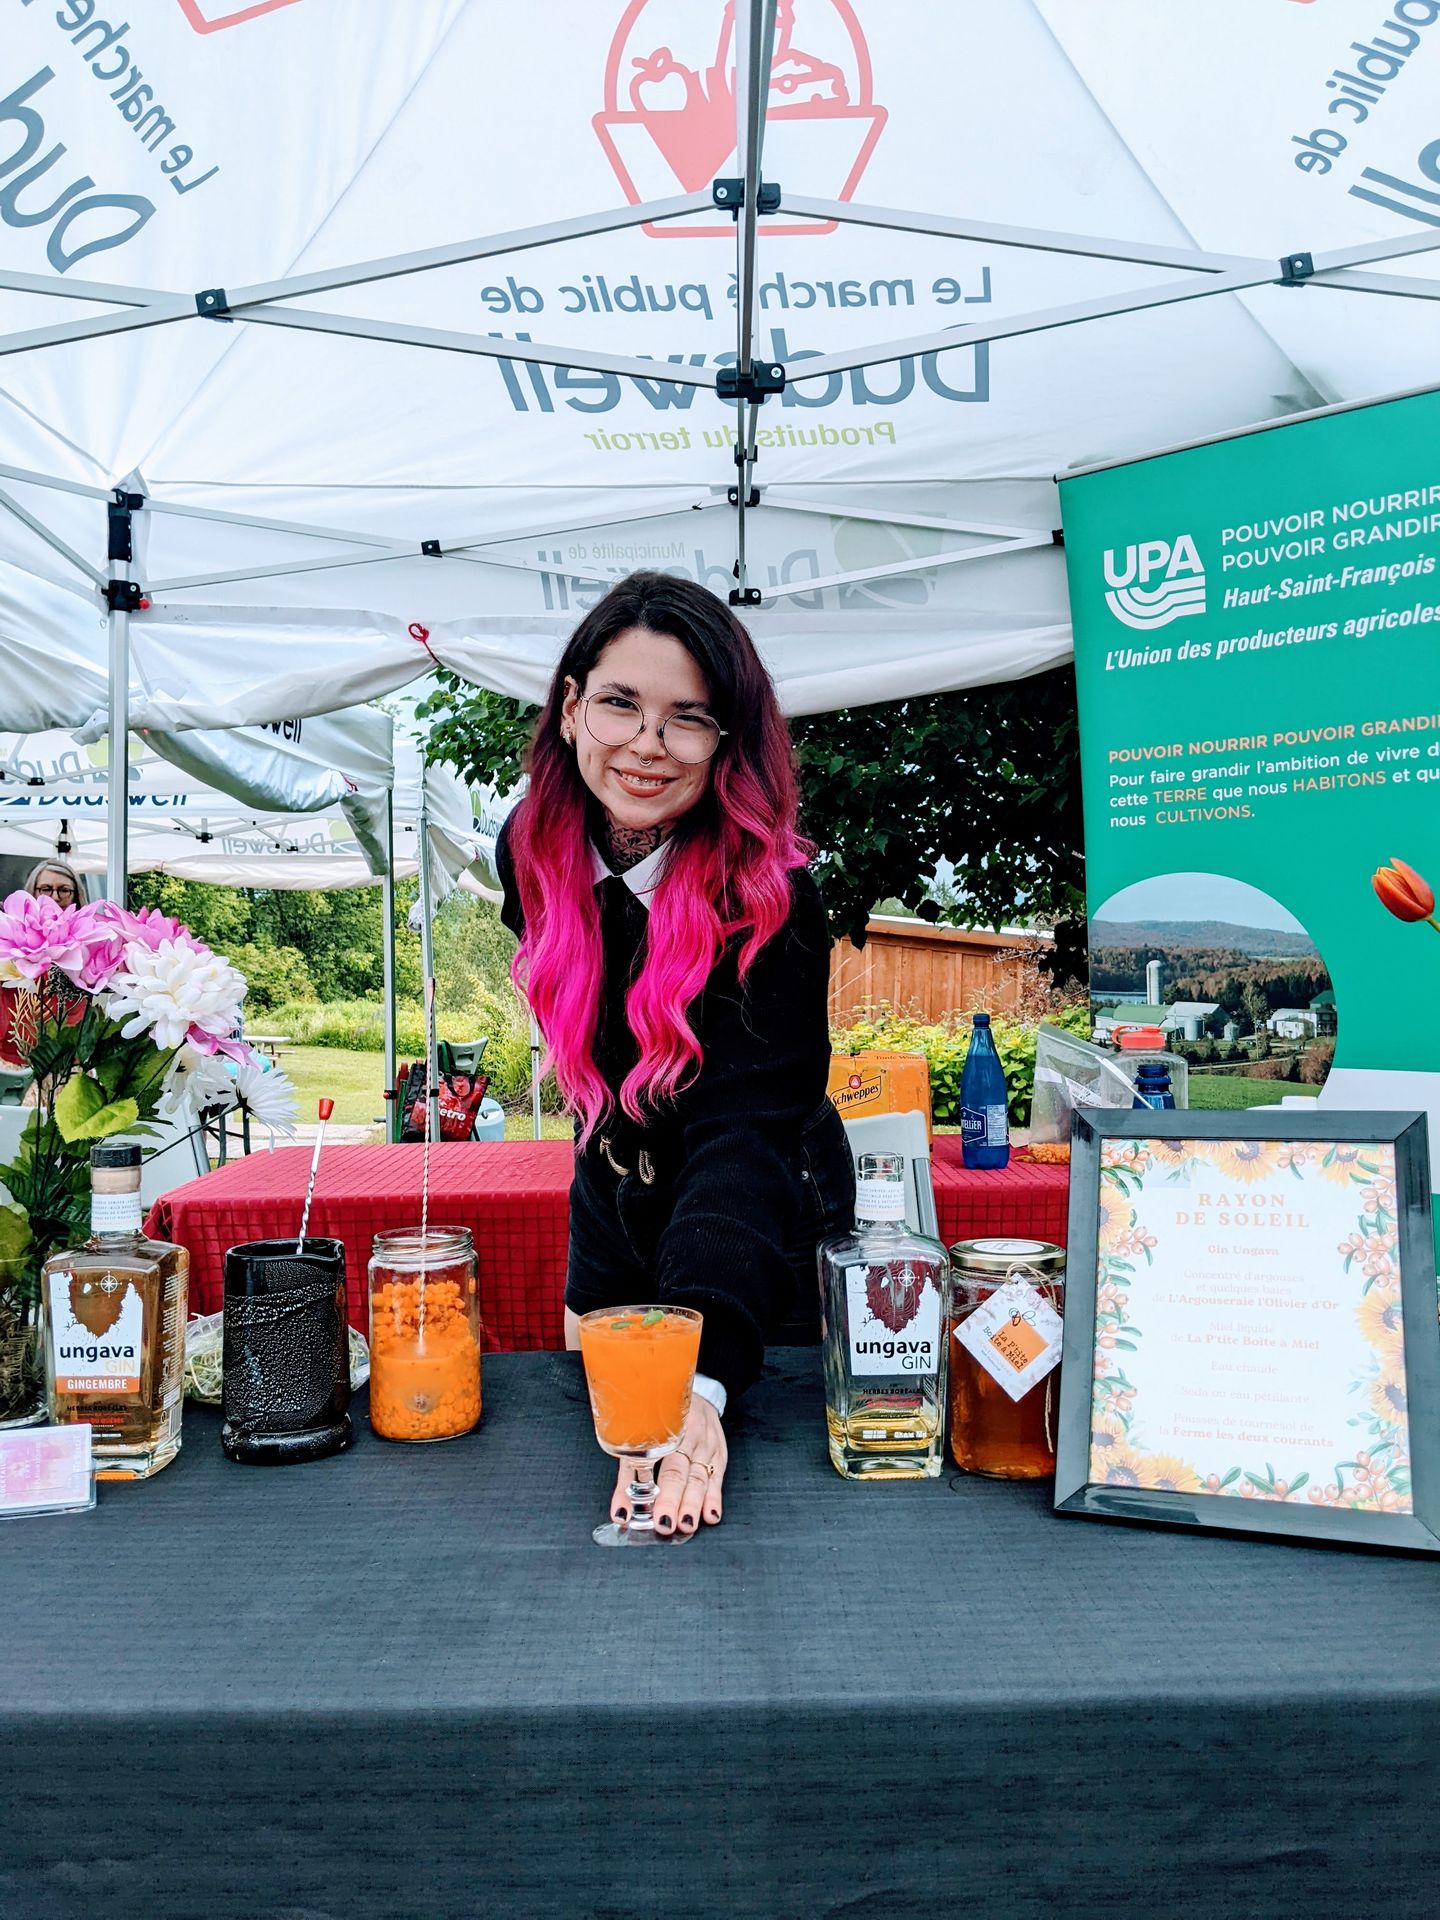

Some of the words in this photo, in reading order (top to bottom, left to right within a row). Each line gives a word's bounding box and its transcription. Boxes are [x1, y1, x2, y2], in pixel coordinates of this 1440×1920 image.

[1221, 510, 1325, 546] POUVOIR
[1103, 534, 1206, 588] UPA
[1221, 537, 1326, 572] POUVOIR
[1223, 553, 1437, 609] Haut-Saint-François
[1105, 646, 1172, 671] L'Union
[1177, 639, 1212, 662] des
[1216, 622, 1338, 660] producteurs
[1108, 743, 1183, 764] POUVOIR
[1188, 735, 1268, 755] NOURRIR
[1273, 725, 1355, 747] POUVOIR
[1360, 713, 1440, 737] GRANDI
[1109, 773, 1144, 788] Pour
[1150, 769, 1185, 784] faire
[1191, 763, 1250, 784] grandir
[1256, 755, 1340, 774] l'ambition
[1346, 750, 1369, 765] de
[1375, 745, 1420, 762] vivre
[1110, 792, 1148, 808] cette
[1153, 787, 1207, 804] TERRE
[1212, 785, 1243, 802] que
[1248, 781, 1288, 796] nous
[1292, 770, 1387, 793] HABITONS
[1392, 768, 1411, 783] et
[1110, 813, 1146, 828] nous
[1155, 804, 1256, 825] CULTIVONS.
[832, 1083, 880, 1107] Schweppes
[1198, 1193, 1285, 1208] RAYON
[1175, 1211, 1206, 1225] DE
[1218, 1212, 1310, 1229] SOLEIL
[1207, 1244, 1229, 1255] Gin
[1232, 1245, 1280, 1257] Ungava
[1168, 1293, 1254, 1308] L'Argouseraie
[1311, 1299, 1340, 1310] d'Or
[855, 1341, 931, 1359] ungava
[1187, 1333, 1202, 1344] La
[1291, 1338, 1320, 1351] Miel
[59, 1345, 135, 1362] ungava
[901, 1355, 931, 1370] GIN
[105, 1359, 135, 1374] GIN
[66, 1379, 128, 1391] GINGEMBRE
[1172, 1426, 1212, 1439] Ferme
[1216, 1429, 1235, 1440] les
[1237, 1431, 1270, 1444] deux
[1273, 1434, 1335, 1448] courants
